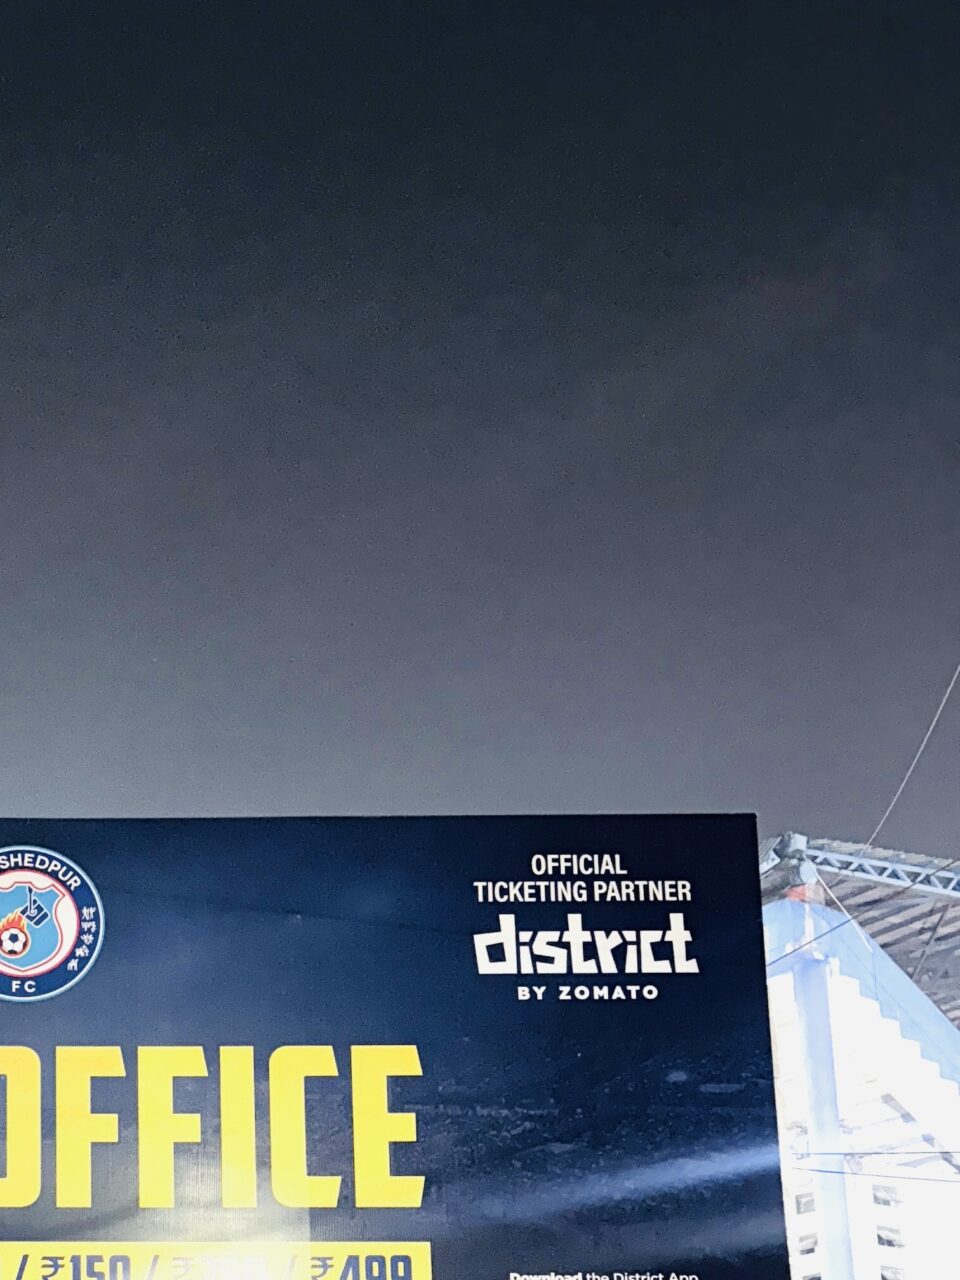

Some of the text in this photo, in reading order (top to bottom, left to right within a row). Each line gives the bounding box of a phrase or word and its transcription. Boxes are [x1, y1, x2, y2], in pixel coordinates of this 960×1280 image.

[531, 854, 628, 876] OFFICIAL
[474, 880, 692, 903] TICKETING PARTNER
[474, 912, 700, 975] district
[12, 979, 37, 993] FC
[517, 985, 659, 1001] BY ZOMATO
